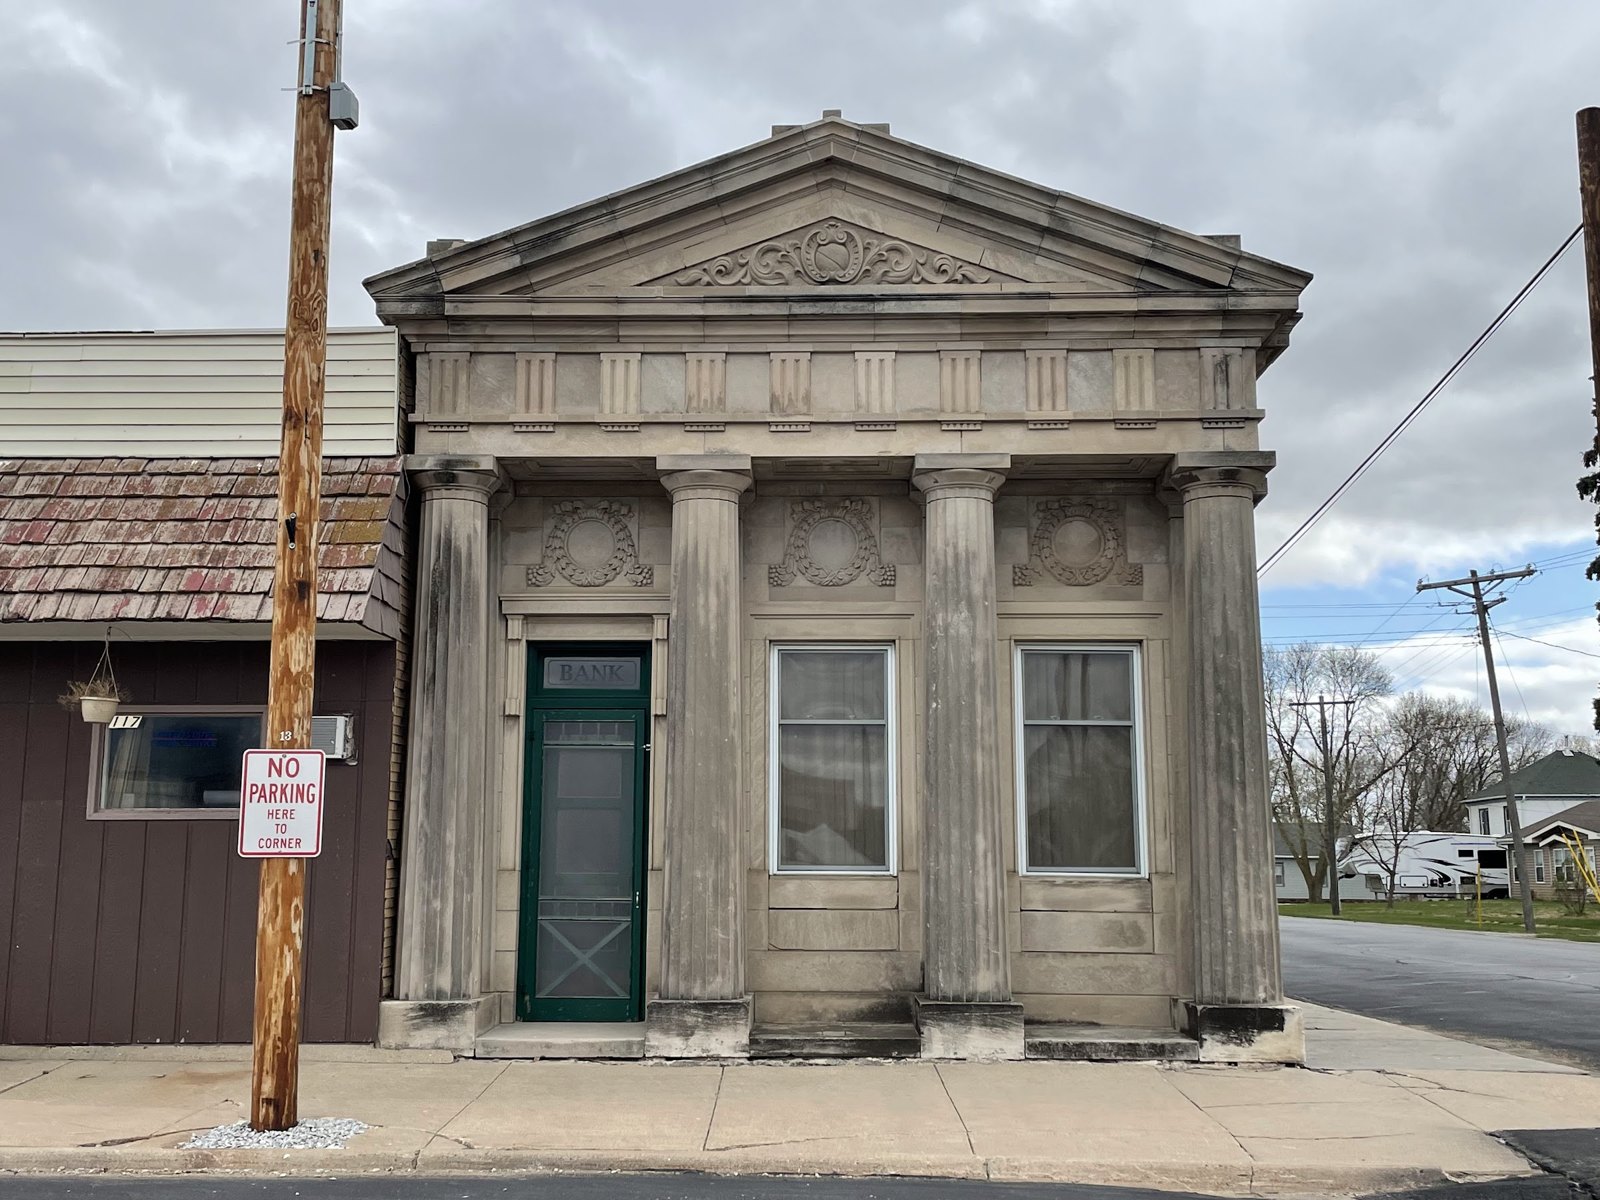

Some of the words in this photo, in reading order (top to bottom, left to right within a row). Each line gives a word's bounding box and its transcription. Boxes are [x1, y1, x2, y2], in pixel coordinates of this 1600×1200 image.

[559, 664, 624, 681] BANK
[113, 716, 141, 727] 117
[268, 757, 300, 778] NO
[249, 783, 316, 804] PARKING
[267, 809, 295, 820] HERE
[275, 823, 287, 834] TO
[258, 838, 302, 849] CORNER
